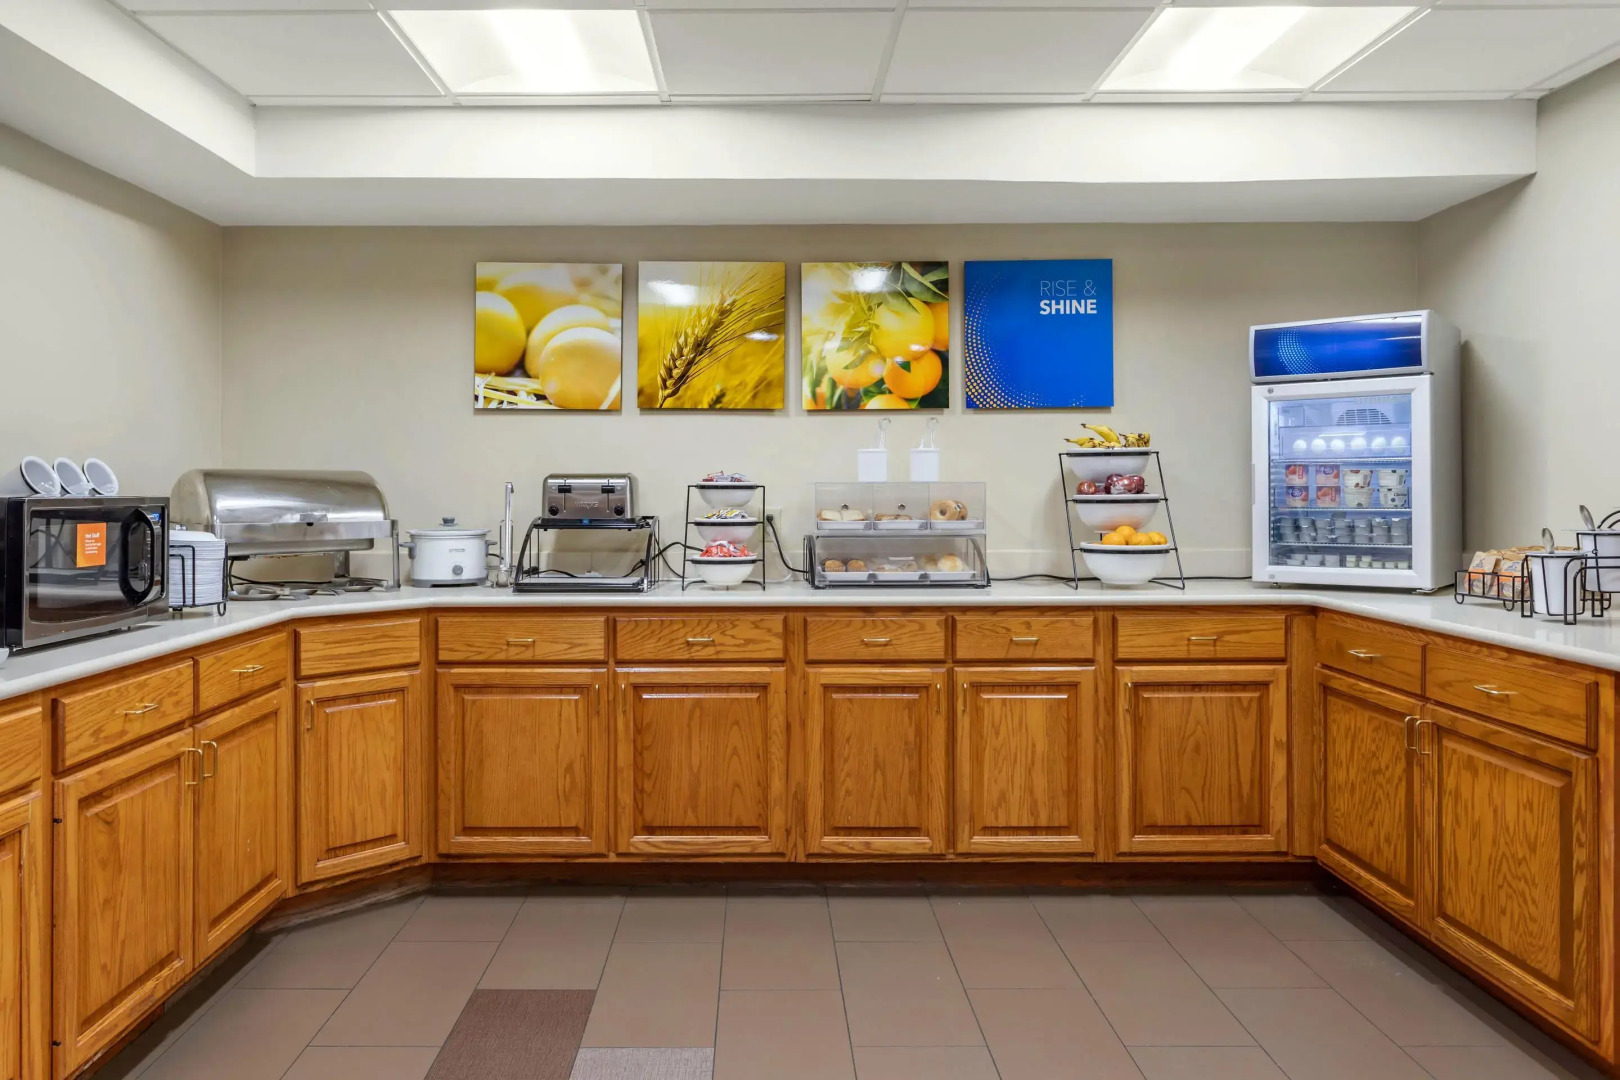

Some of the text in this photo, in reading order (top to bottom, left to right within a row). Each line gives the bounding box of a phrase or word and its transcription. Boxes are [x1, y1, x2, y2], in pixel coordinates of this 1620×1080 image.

[1040, 279, 1097, 297] RISE &
[1039, 299, 1097, 315] SHINE
